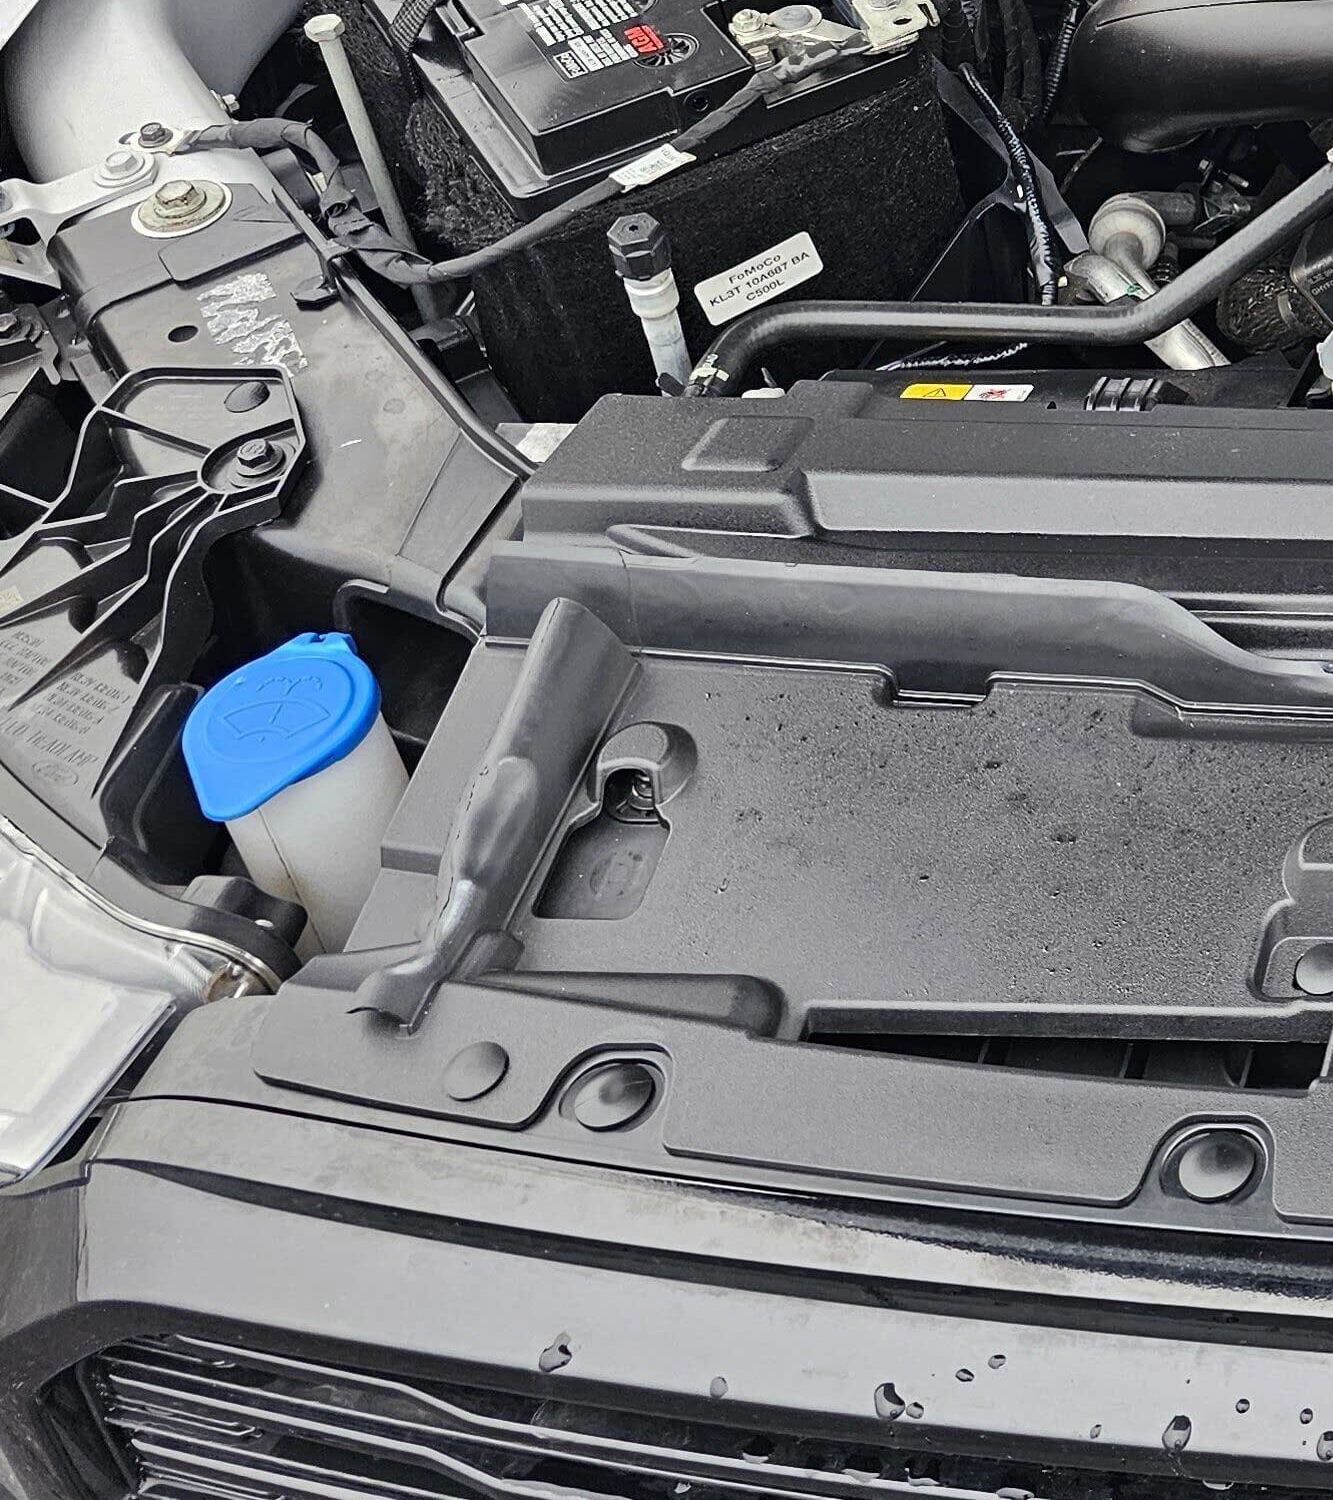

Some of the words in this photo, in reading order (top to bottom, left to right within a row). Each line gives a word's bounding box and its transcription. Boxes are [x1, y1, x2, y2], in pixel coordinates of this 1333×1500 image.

[624, 26, 659, 54] AGM
[709, 285, 745, 308] KL3T
[791, 251, 811, 267] BA
[728, 254, 782, 284] FoMoCo
[746, 279, 786, 302] C500L
